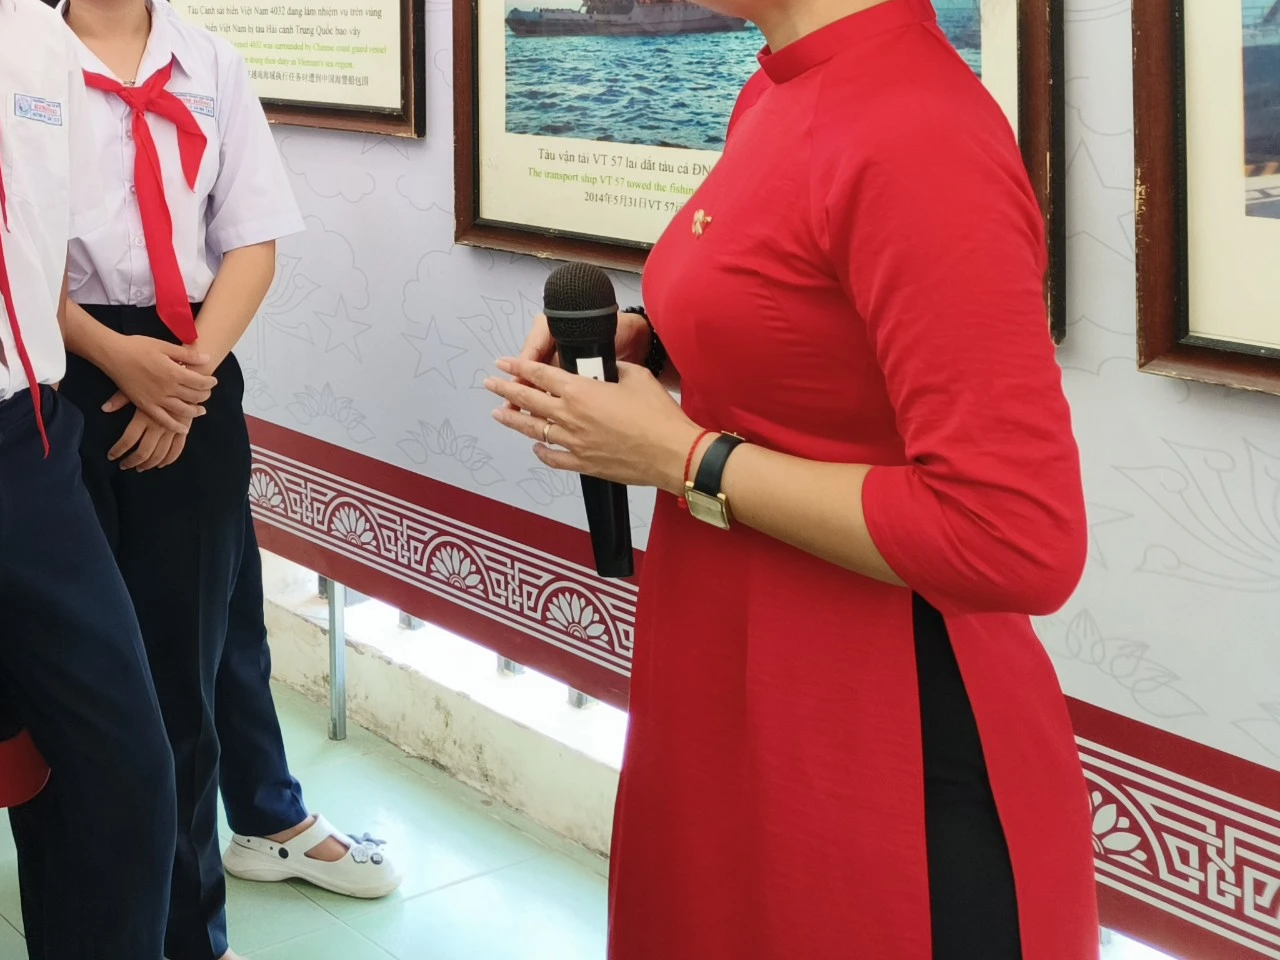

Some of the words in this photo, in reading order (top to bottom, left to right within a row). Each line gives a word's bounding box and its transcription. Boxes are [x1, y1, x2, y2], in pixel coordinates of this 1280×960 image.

[254, 6, 269, 15] Nam
[270, 6, 285, 16] 4032
[232, 24, 246, 32] Nam
[296, 25, 314, 37] Trung
[538, 148, 555, 160] Tàu
[558, 150, 575, 164] vận
[592, 153, 608, 166] VT
[611, 155, 623, 167] 57
[625, 157, 637, 169] lai
[658, 160, 674, 173] tàu
[677, 163, 689, 174] cá
[528, 167, 542, 177] The
[544, 170, 579, 183] transport
[581, 173, 598, 186] ship
[600, 175, 613, 185] VT
[615, 177, 625, 185] 57
[627, 180, 652, 191] towed
[654, 181, 667, 192] the
[670, 183, 694, 196] fishin
